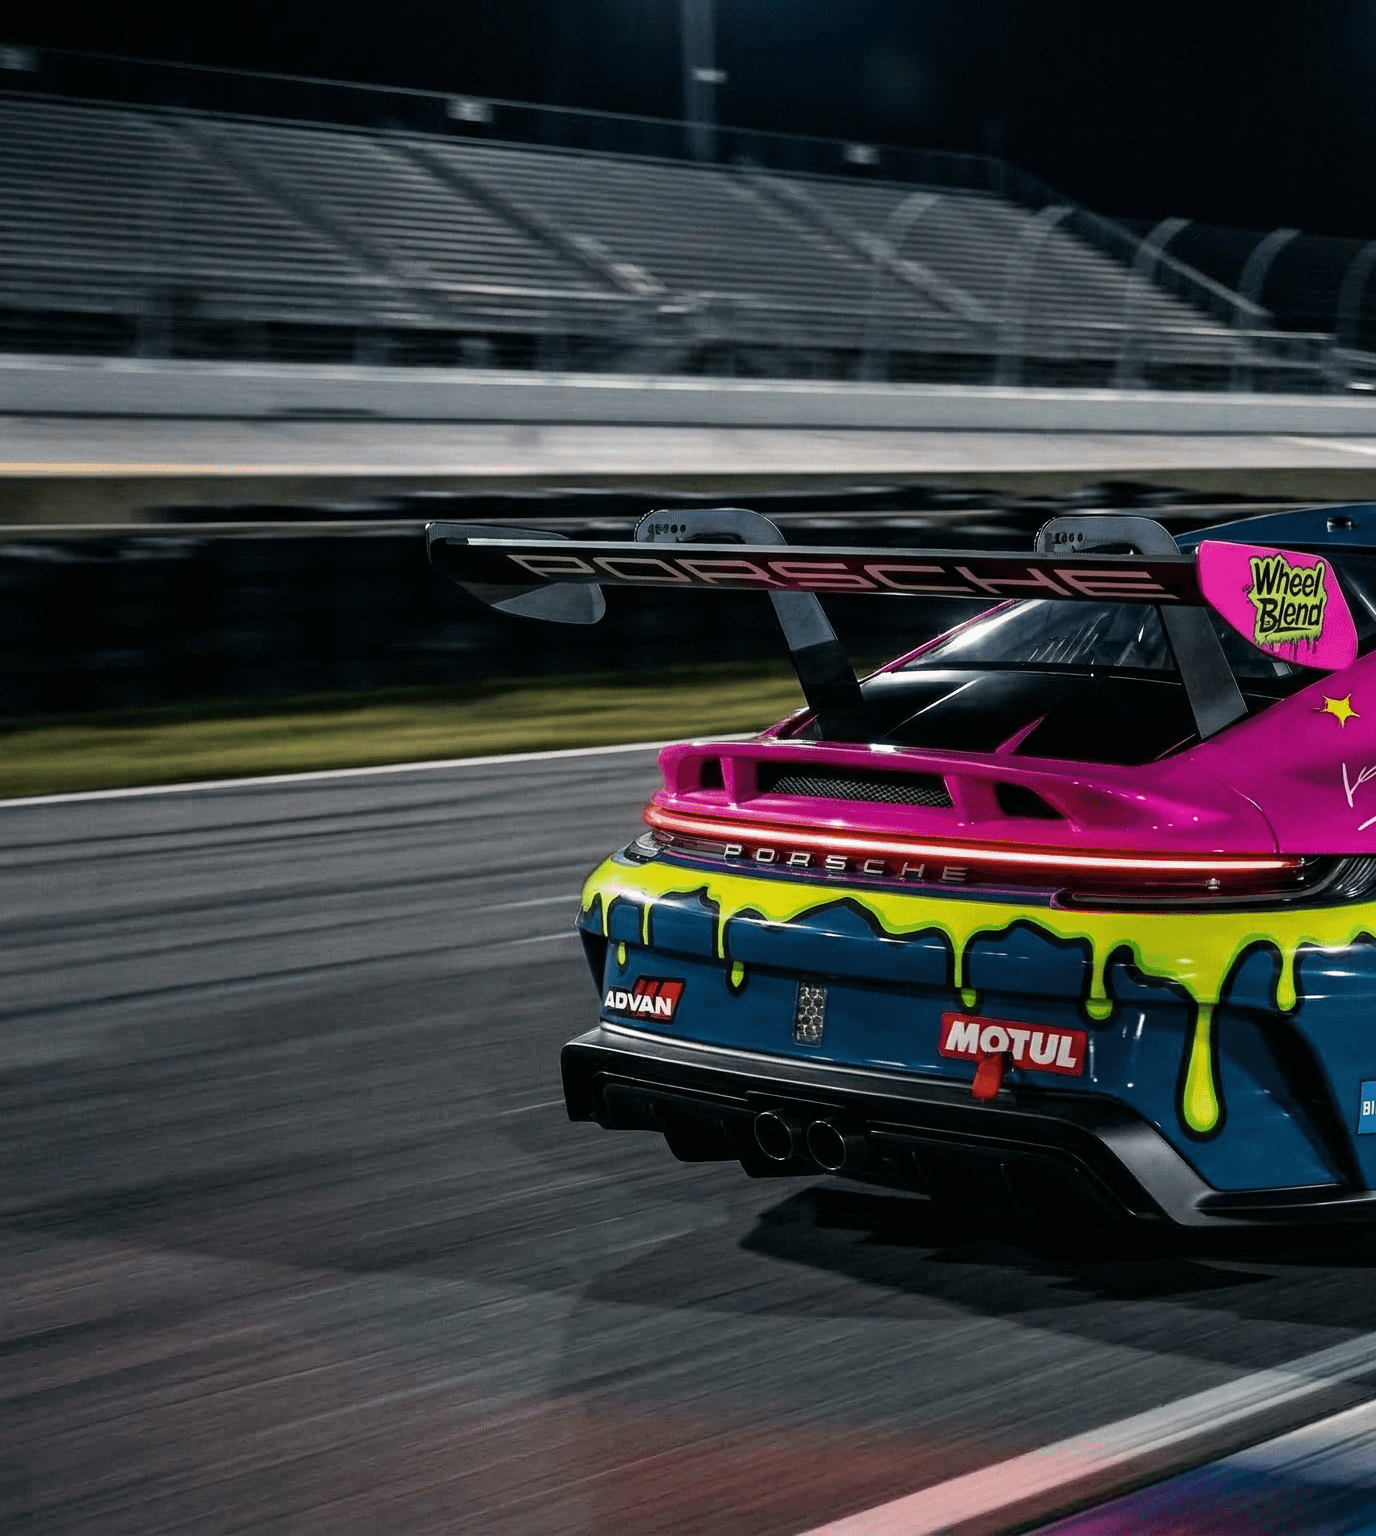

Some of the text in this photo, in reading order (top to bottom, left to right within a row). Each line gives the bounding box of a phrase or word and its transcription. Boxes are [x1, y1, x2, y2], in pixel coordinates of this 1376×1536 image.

[507, 554, 1180, 599] PORSCHE
[1254, 559, 1323, 598] Wheel
[723, 843, 969, 882] PORSCHE
[604, 990, 672, 1016] ADVAN
[945, 1020, 1077, 1068] MOTUL
